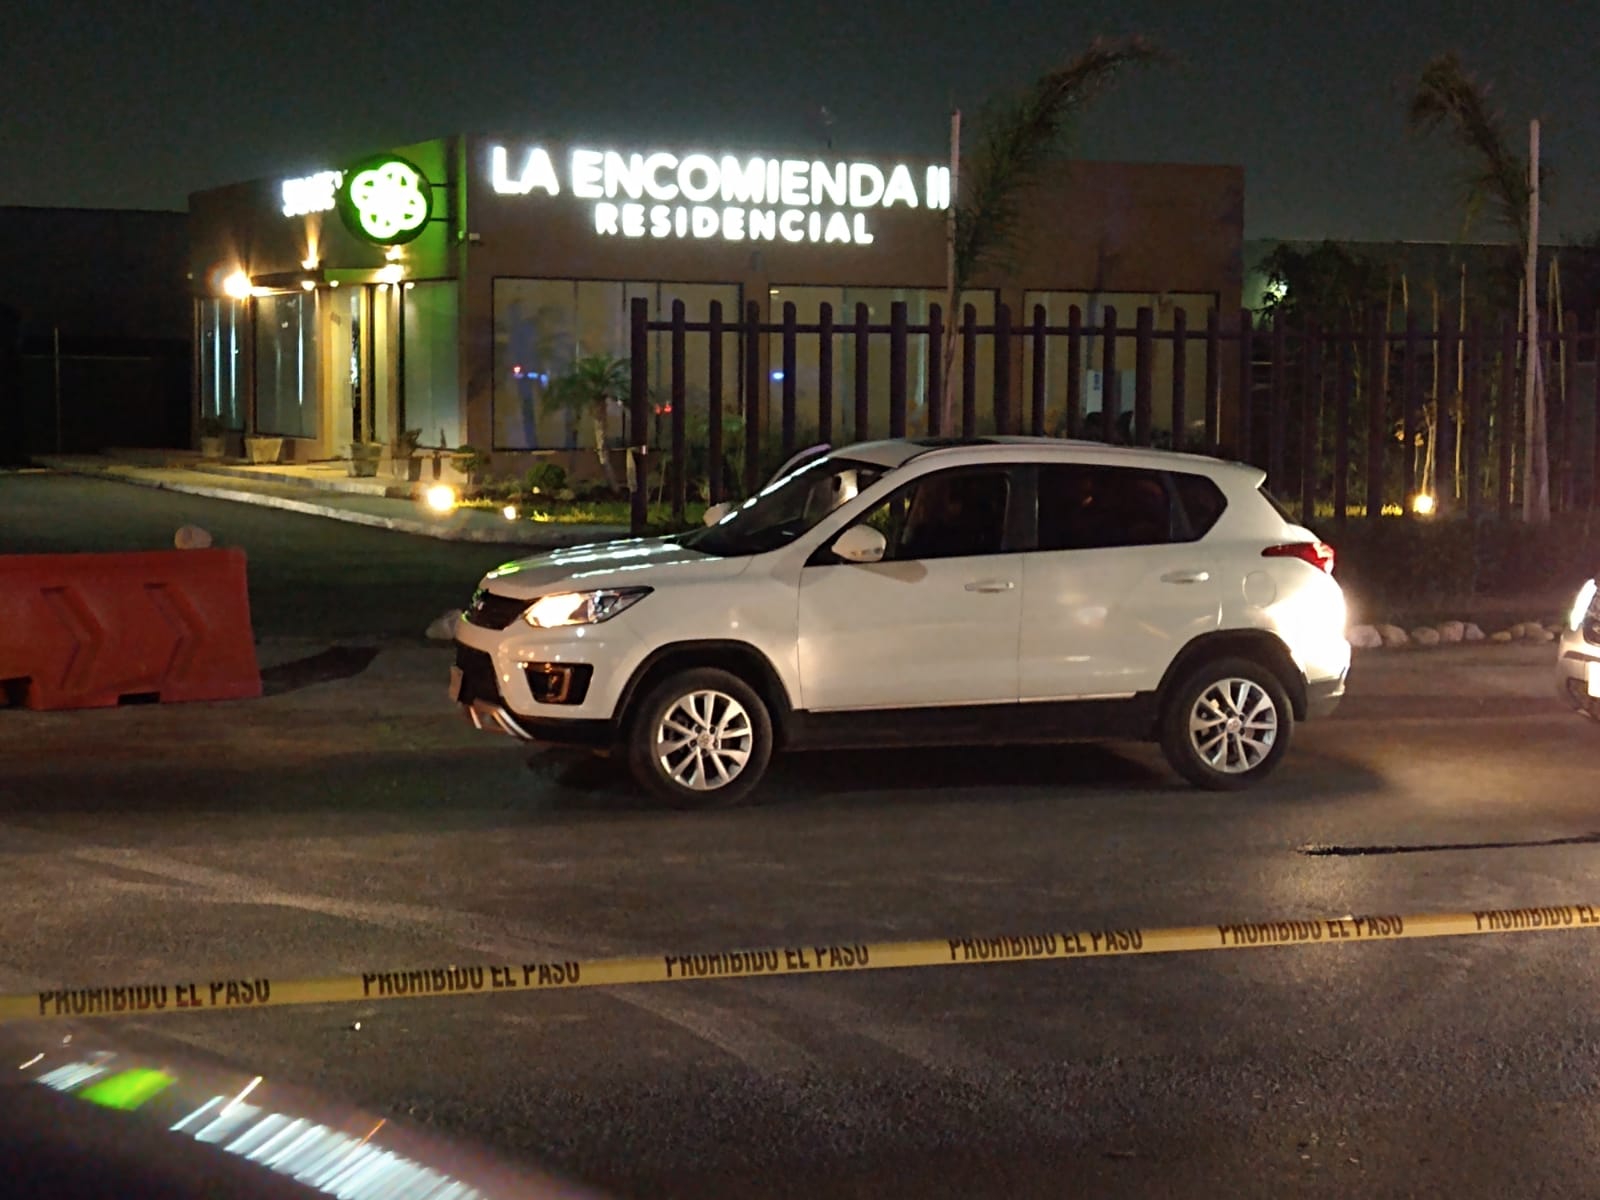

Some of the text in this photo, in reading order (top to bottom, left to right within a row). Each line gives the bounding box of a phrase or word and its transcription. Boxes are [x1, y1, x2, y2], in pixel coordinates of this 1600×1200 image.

[492, 145, 950, 210] LA ENCOMIENDA II
[594, 202, 874, 244] RESIDENCIAL
